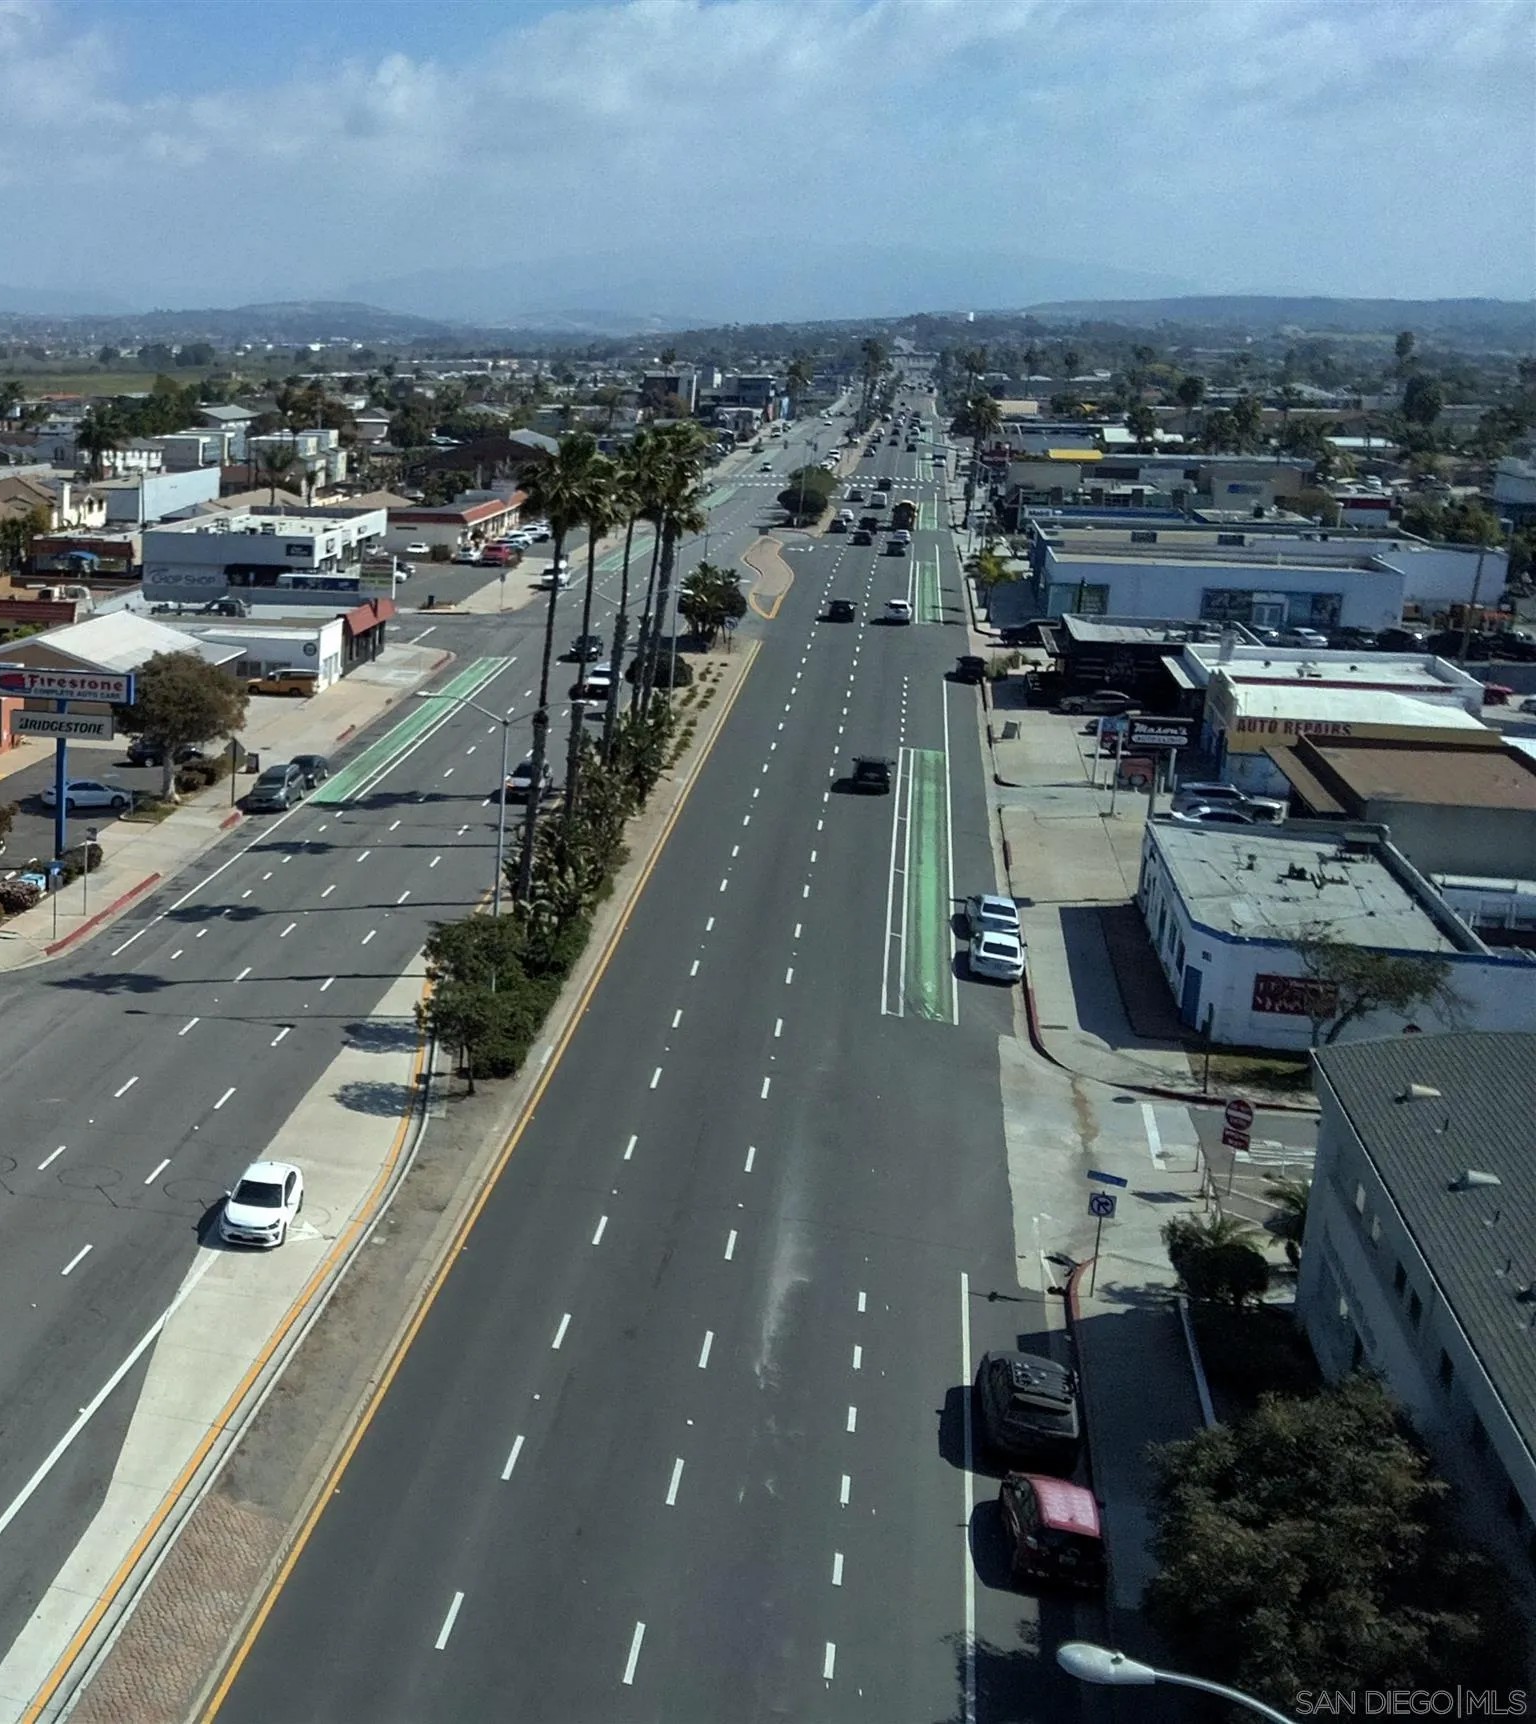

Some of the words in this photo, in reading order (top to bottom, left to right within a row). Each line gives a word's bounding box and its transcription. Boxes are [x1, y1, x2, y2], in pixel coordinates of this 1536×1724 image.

[184, 574, 216, 586] SHOP
[28, 674, 123, 692] Firestone
[19, 718, 105, 734] BRIDGESTONE
[1237, 717, 1279, 734] AUTO
[1284, 720, 1352, 736] REPAIRS
